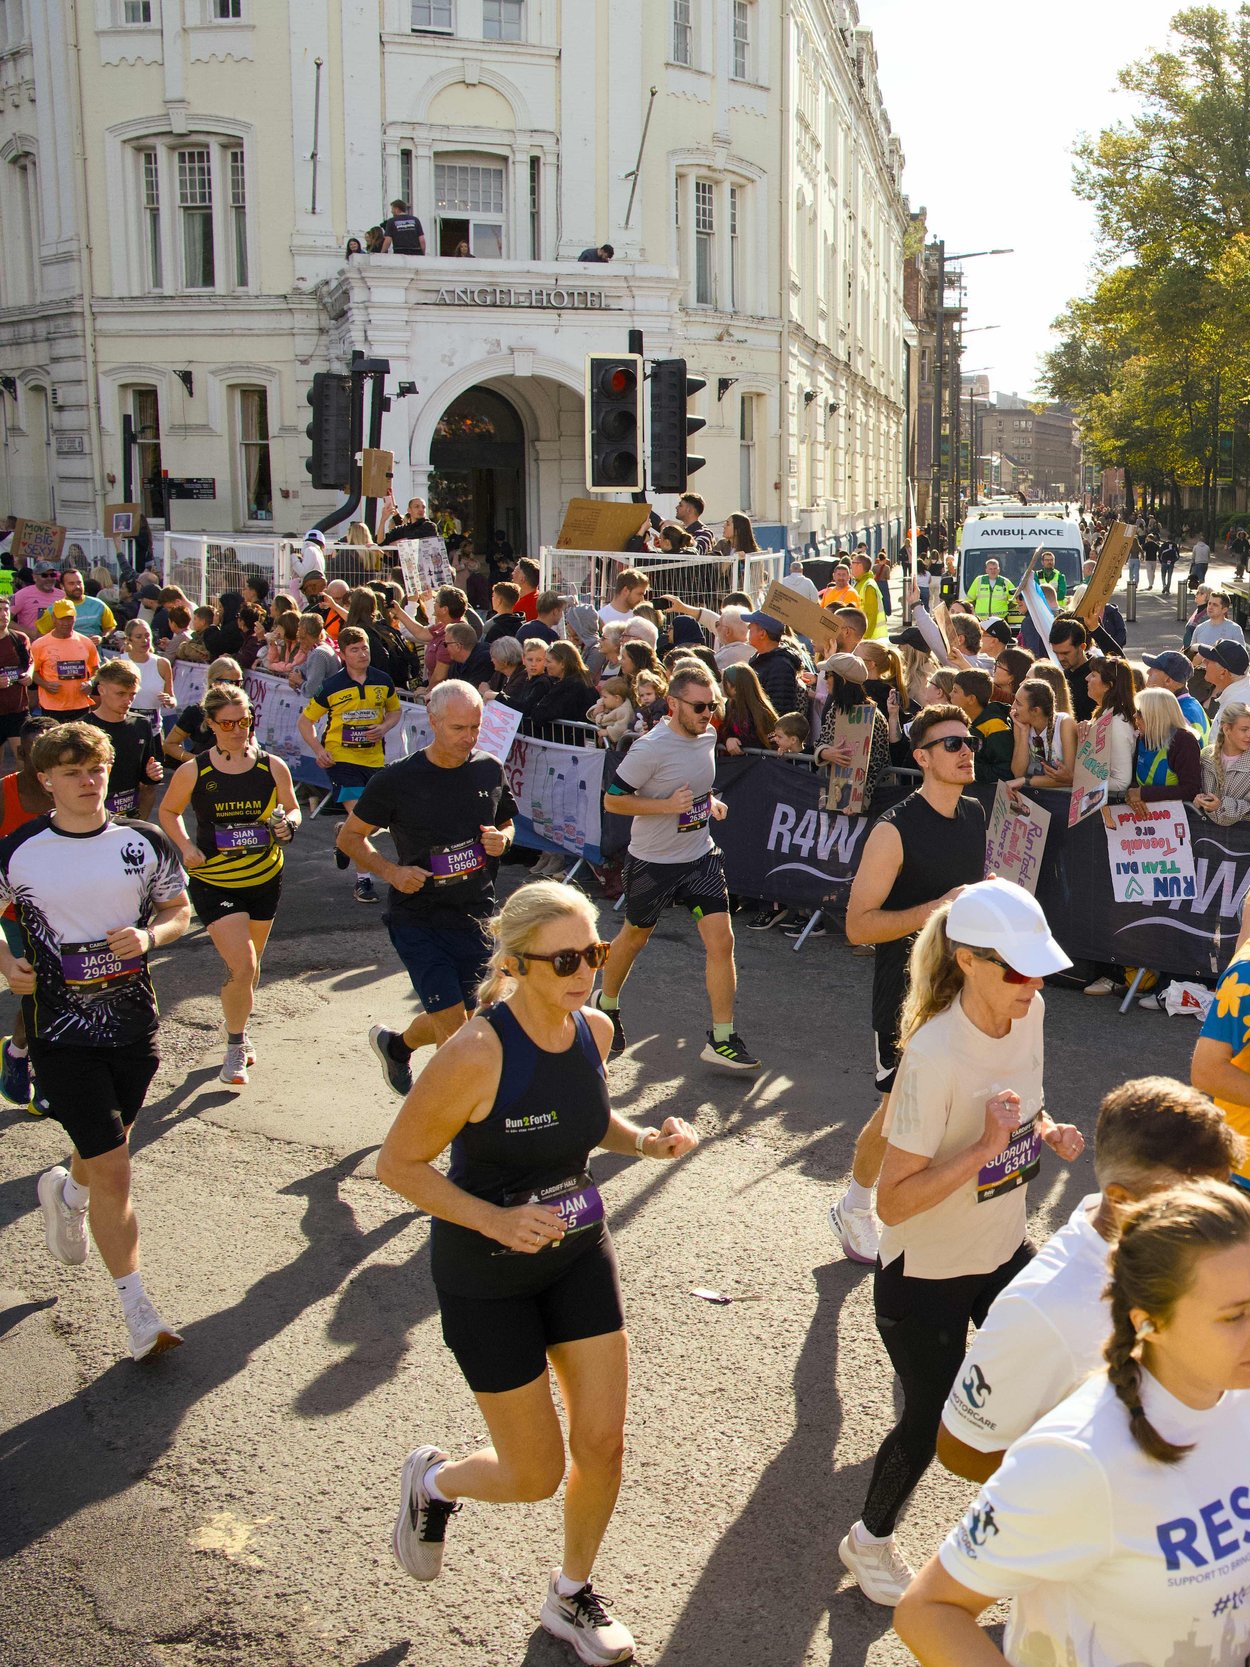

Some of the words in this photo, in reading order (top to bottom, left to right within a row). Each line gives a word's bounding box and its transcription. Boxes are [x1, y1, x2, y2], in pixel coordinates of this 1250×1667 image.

[436, 287, 516, 305] ANGEL
[529, 289, 611, 308] HOTEL
[24, 522, 52, 533] MOVE
[980, 528, 1065, 537] AMBULANCE
[34, 532, 54, 544] BIG
[1096, 712, 1113, 754] Run
[113, 794, 135, 806] HENRY
[215, 800, 262, 812] WITHAM
[1068, 786, 1085, 826] Run
[216, 810, 243, 818] RUNNING
[232, 829, 254, 839] SIAN
[766, 802, 868, 864] R4W
[1025, 820, 1043, 851] Run
[1135, 826, 1156, 836] are
[230, 837, 258, 847] 14960
[1003, 817, 1028, 868] Emily
[1121, 837, 1178, 857] Toenails
[448, 849, 475, 864] EMYR
[124, 867, 146, 876] WWF
[448, 858, 477, 873] 19560
[1017, 850, 1037, 888] Faste
[1116, 862, 1139, 875] DAI
[1142, 860, 1181, 874] TEAM
[1153, 875, 1195, 898] RUN
[83, 961, 122, 980] 29430
[505, 1111, 558, 1129] Run2Forty2
[1011, 1125, 1032, 1138] CARDIFF
[985, 1138, 1031, 1169] GUDRUN
[1004, 1150, 1032, 1175] 6341
[540, 1183, 564, 1197] CARDIFF
[563, 1178, 577, 1189] HALF
[1167, 1570, 1216, 1588] SUPPORT
[1217, 1564, 1230, 1576] TO
